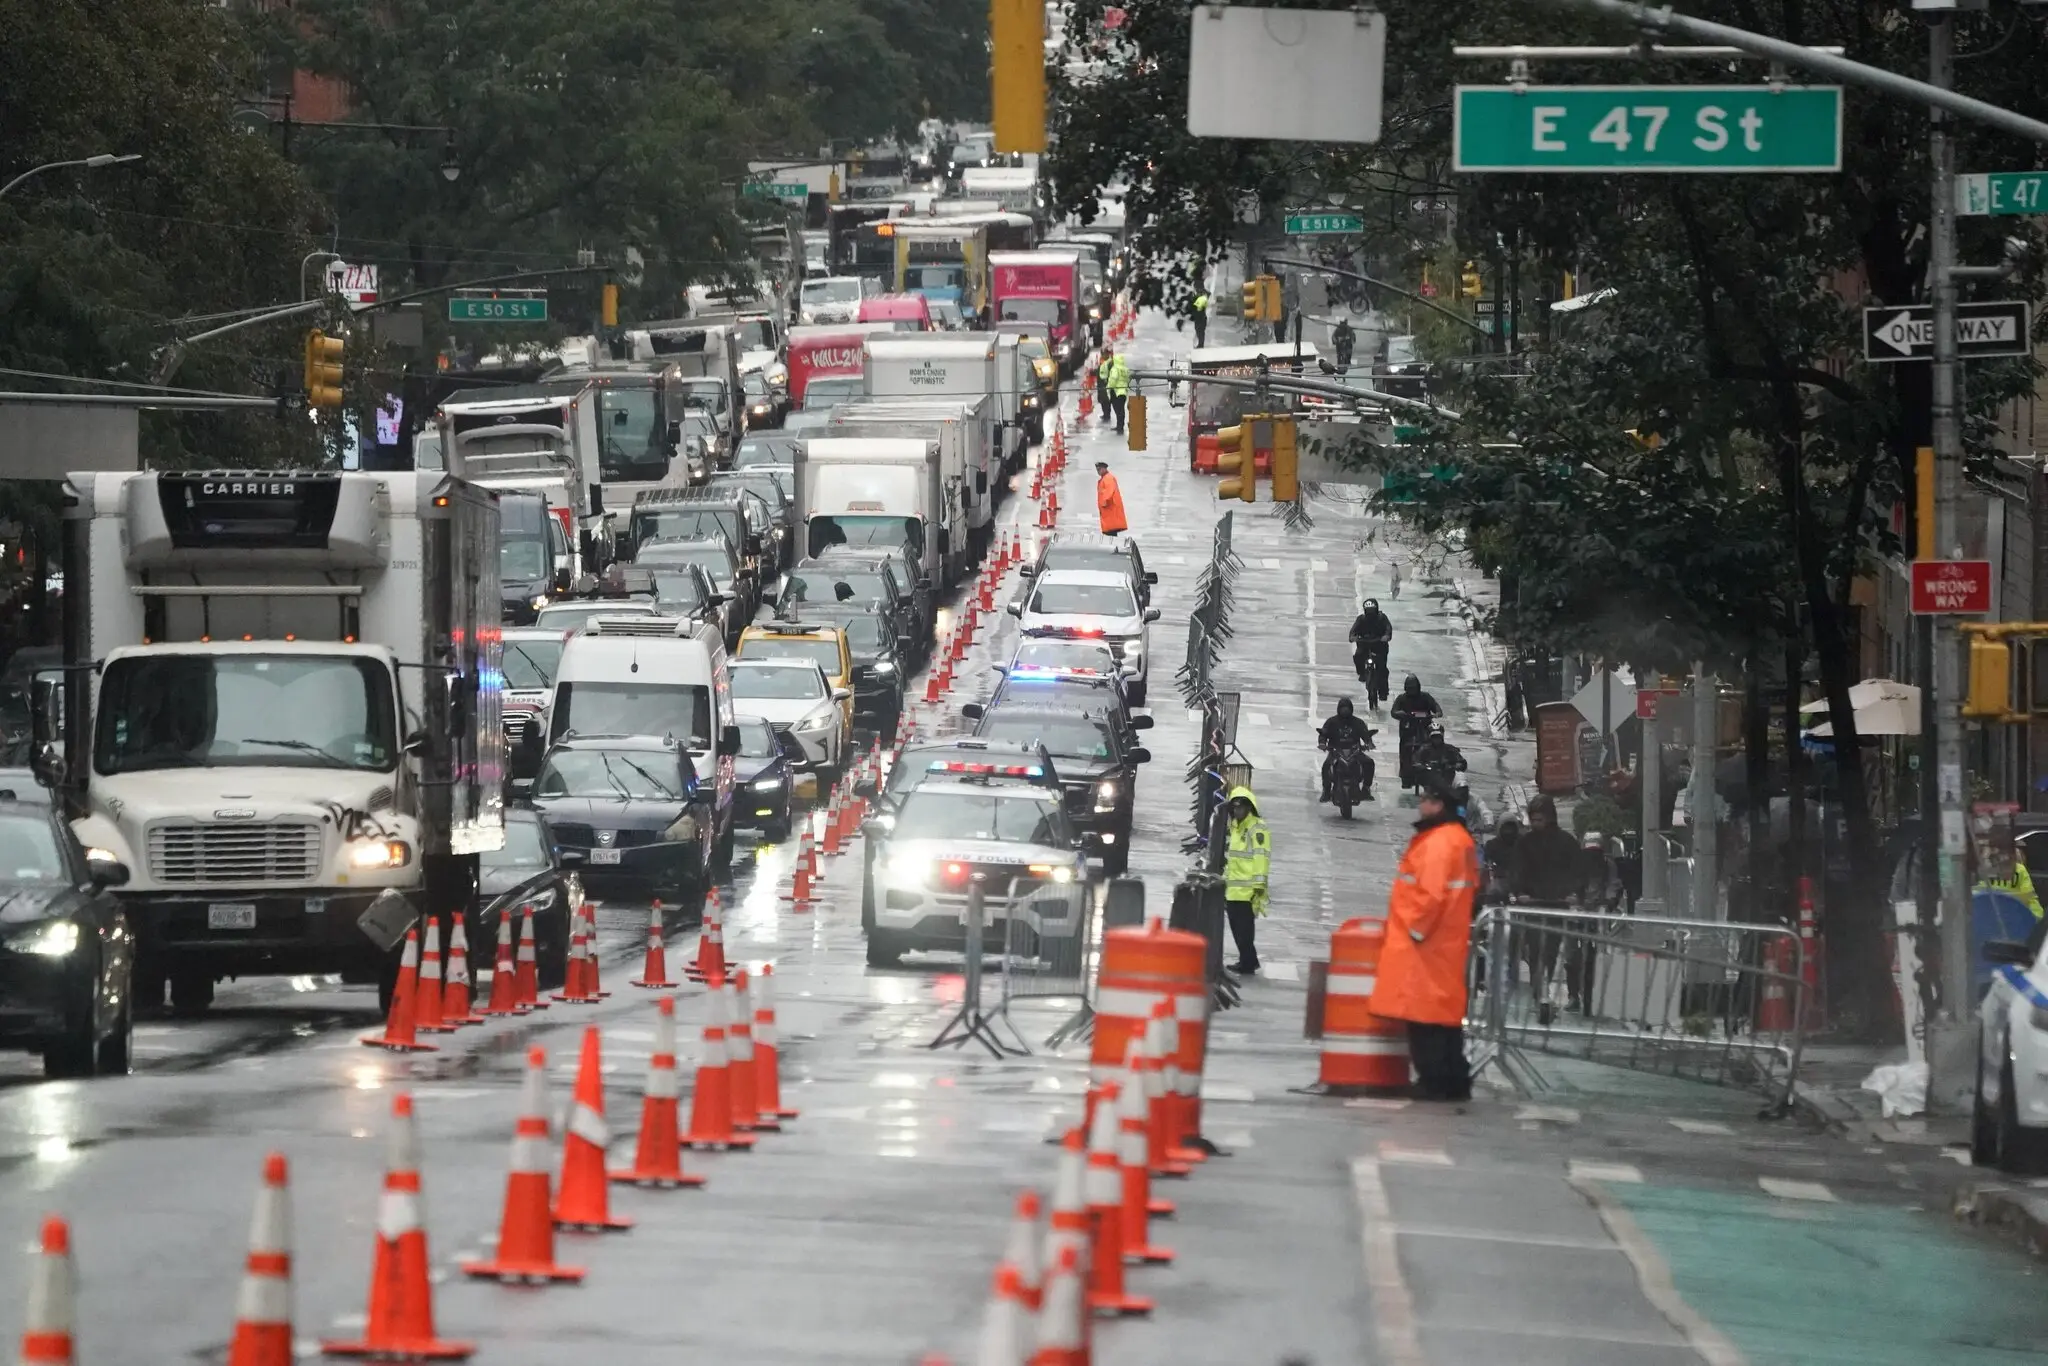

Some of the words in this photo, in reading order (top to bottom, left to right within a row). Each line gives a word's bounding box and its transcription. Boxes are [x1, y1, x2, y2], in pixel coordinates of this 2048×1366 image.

[1532, 106, 1567, 152] E
[1589, 106, 1670, 152] 47
[1692, 105, 1763, 152] St
[1992, 180, 2004, 209] E
[2013, 178, 2042, 208] 47
[1302, 218, 1310, 229] E
[1314, 218, 1327, 229] 51
[1332, 218, 1346, 229] St
[330, 265, 375, 289] ZZA
[467, 304, 477, 316] E
[483, 304, 504, 316] 50
[510, 304, 529, 316] St
[1891, 322, 1934, 343] ONE
[1957, 318, 2006, 341] WAY
[203, 482, 295, 495] CARRIER
[1925, 580, 1978, 594] WRONG
[1935, 595, 1967, 608] WAY
[978, 855, 1026, 865] POLICE
